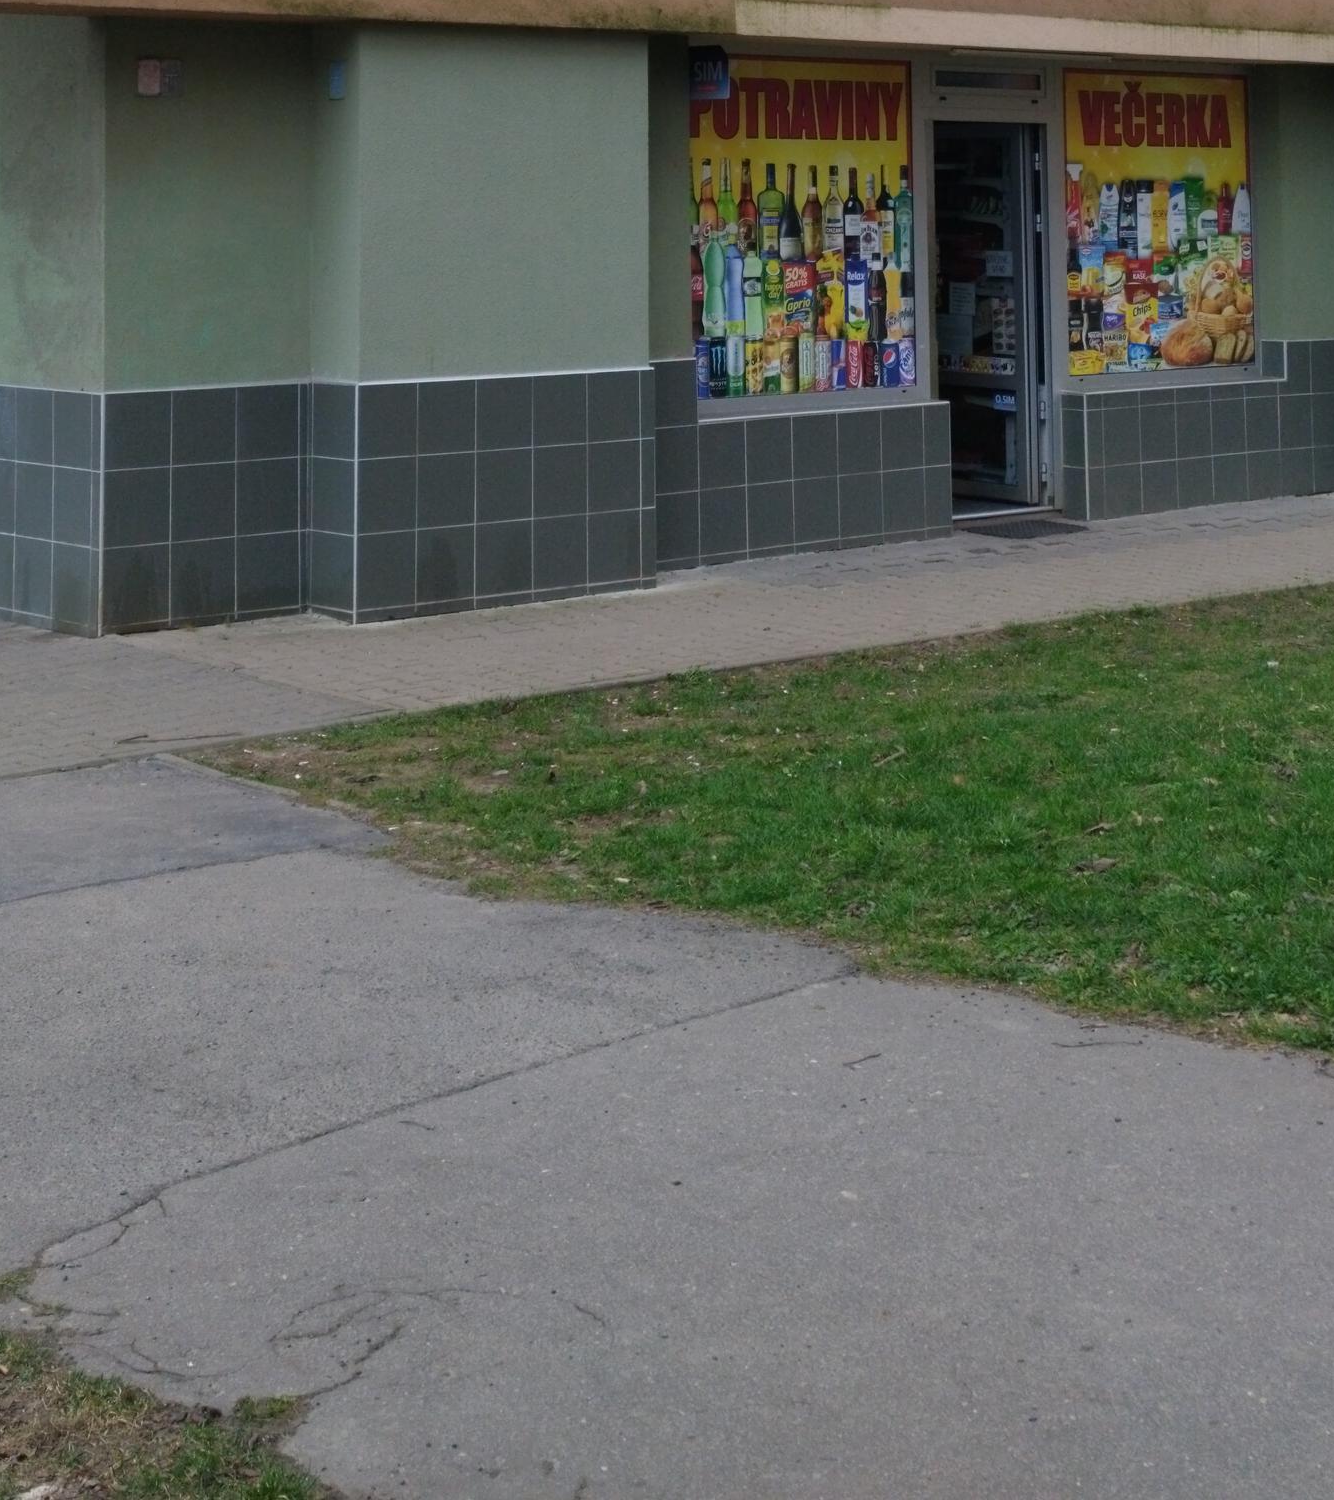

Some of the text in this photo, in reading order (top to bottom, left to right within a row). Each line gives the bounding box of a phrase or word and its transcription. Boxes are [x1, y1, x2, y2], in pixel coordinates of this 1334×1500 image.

[693, 60, 723, 82] SIM
[1078, 81, 1232, 148] VEČERKA
[785, 265, 808, 282] 50%
[847, 271, 864, 281] Relax
[765, 283, 783, 293] happy
[785, 279, 808, 289] GRATIS
[768, 290, 780, 301] day
[785, 297, 811, 314] Caprio
[1133, 303, 1152, 316] Chips
[1104, 334, 1127, 342] HARIBO
